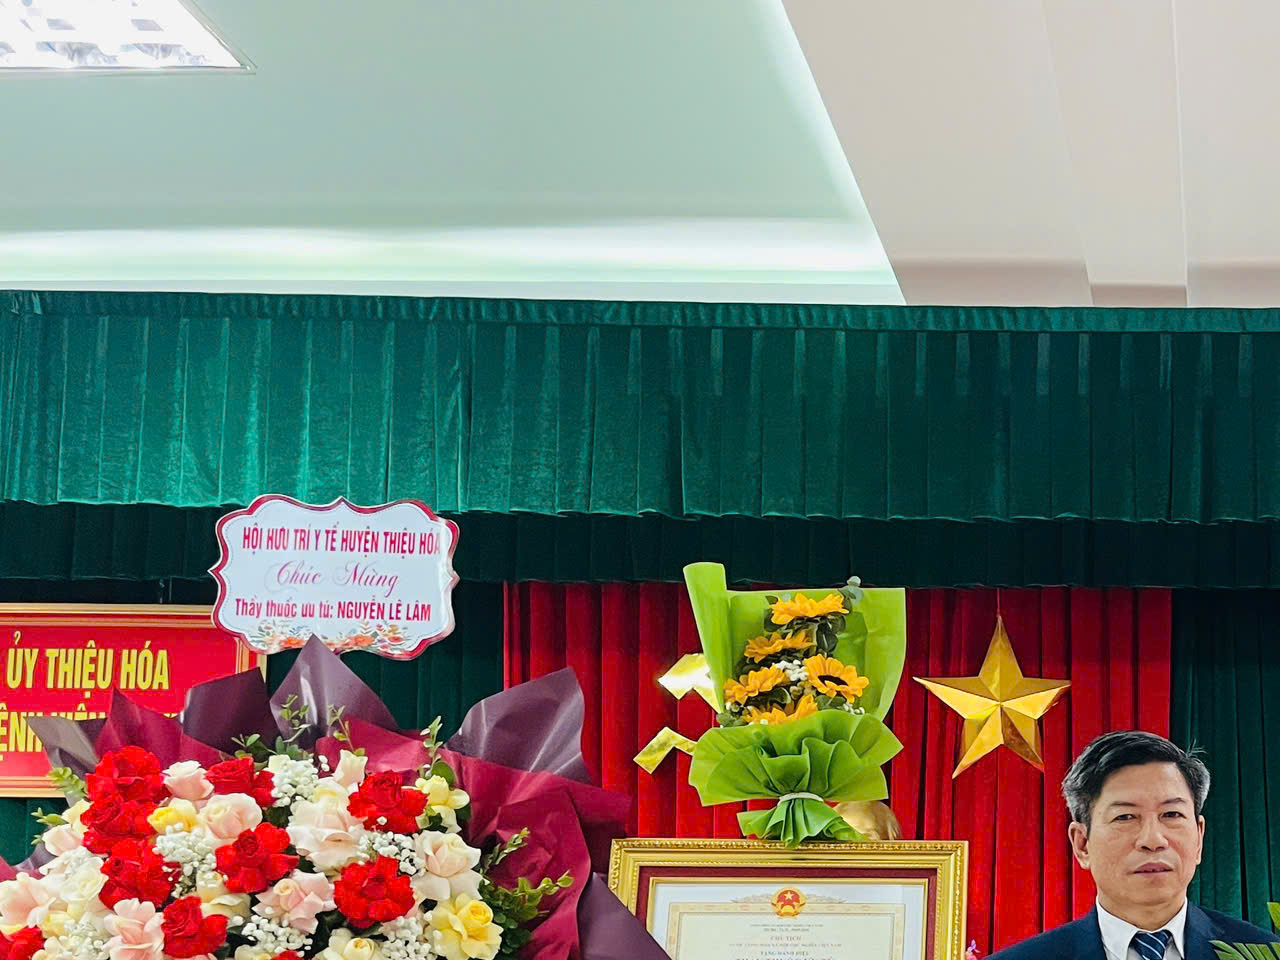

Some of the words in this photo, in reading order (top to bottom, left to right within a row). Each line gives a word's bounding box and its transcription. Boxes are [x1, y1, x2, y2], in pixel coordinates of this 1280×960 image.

[242, 522, 262, 555] HỘI
[293, 523, 312, 551] TRÍ
[314, 528, 322, 551] Y
[324, 521, 340, 552] TẾ
[340, 525, 381, 557] HUYỆN
[383, 527, 415, 559] THIỆU
[271, 560, 323, 588] Chúc
[337, 560, 399, 598] Mừng
[235, 595, 262, 619] Thầy
[266, 597, 297, 618] thuốc
[337, 595, 385, 620] NGUYỄN
[388, 599, 401, 621] LÊ
[405, 599, 432, 622] LÂM
[6, 630, 39, 689] ỦY
[46, 639, 114, 698] THIỆU
[120, 640, 170, 690] HÓA
[0, 703, 44, 761] ỆNH
